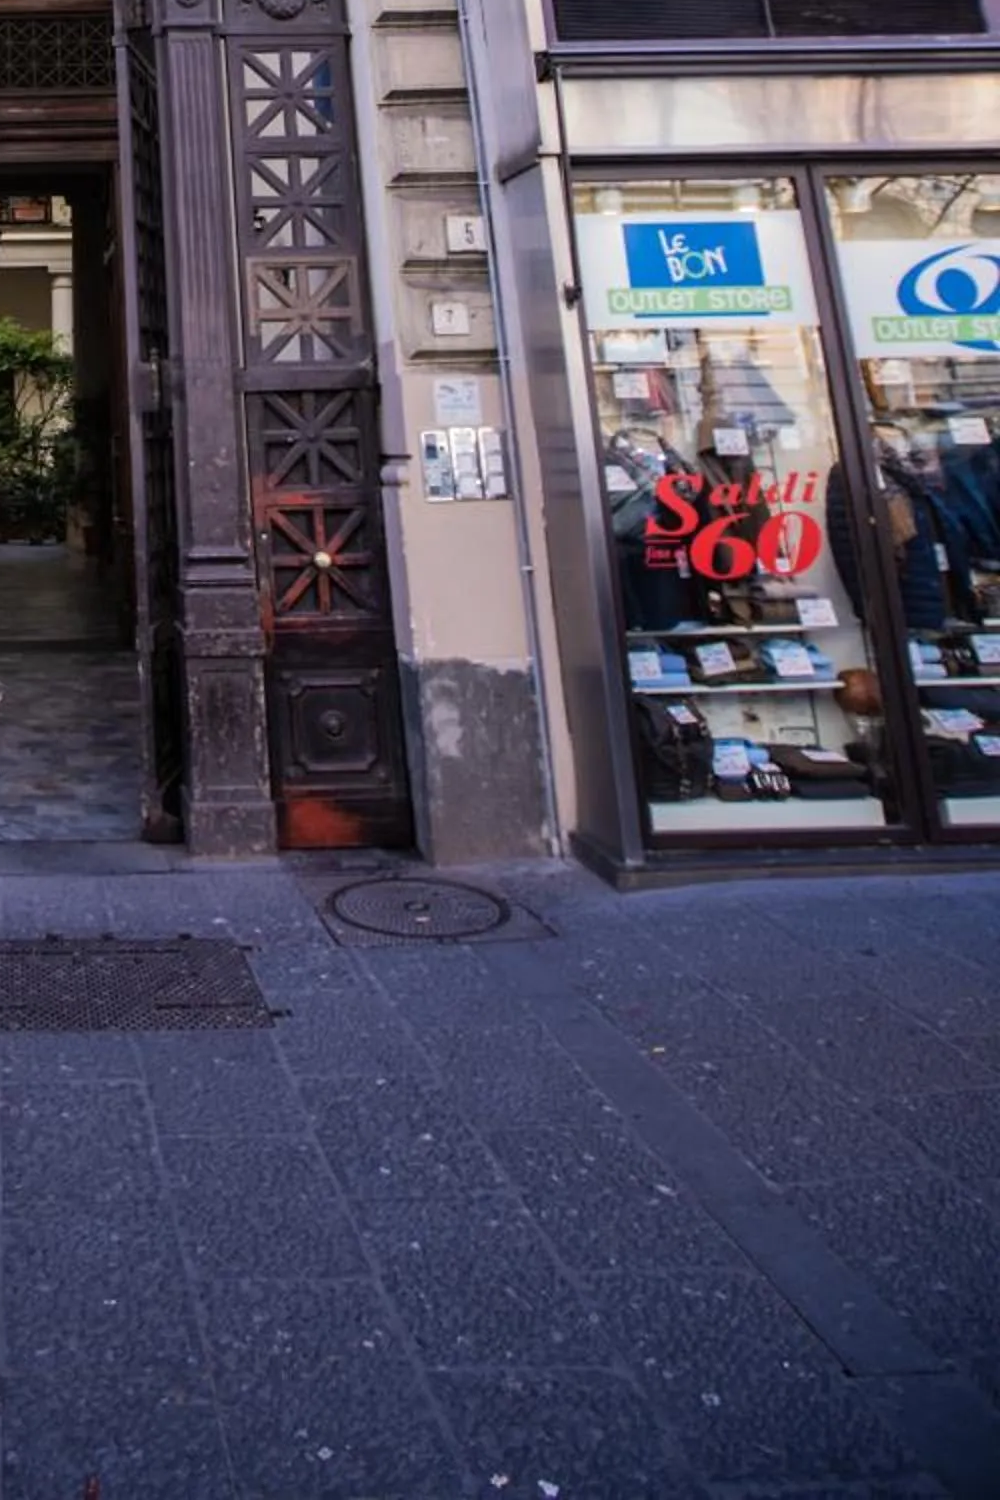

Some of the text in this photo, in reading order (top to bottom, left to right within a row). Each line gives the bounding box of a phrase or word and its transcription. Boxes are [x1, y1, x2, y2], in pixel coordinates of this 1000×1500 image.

[464, 222, 475, 244] 5
[665, 245, 729, 283] BON
[645, 470, 819, 537] Saldi
[690, 511, 823, 580] 60
